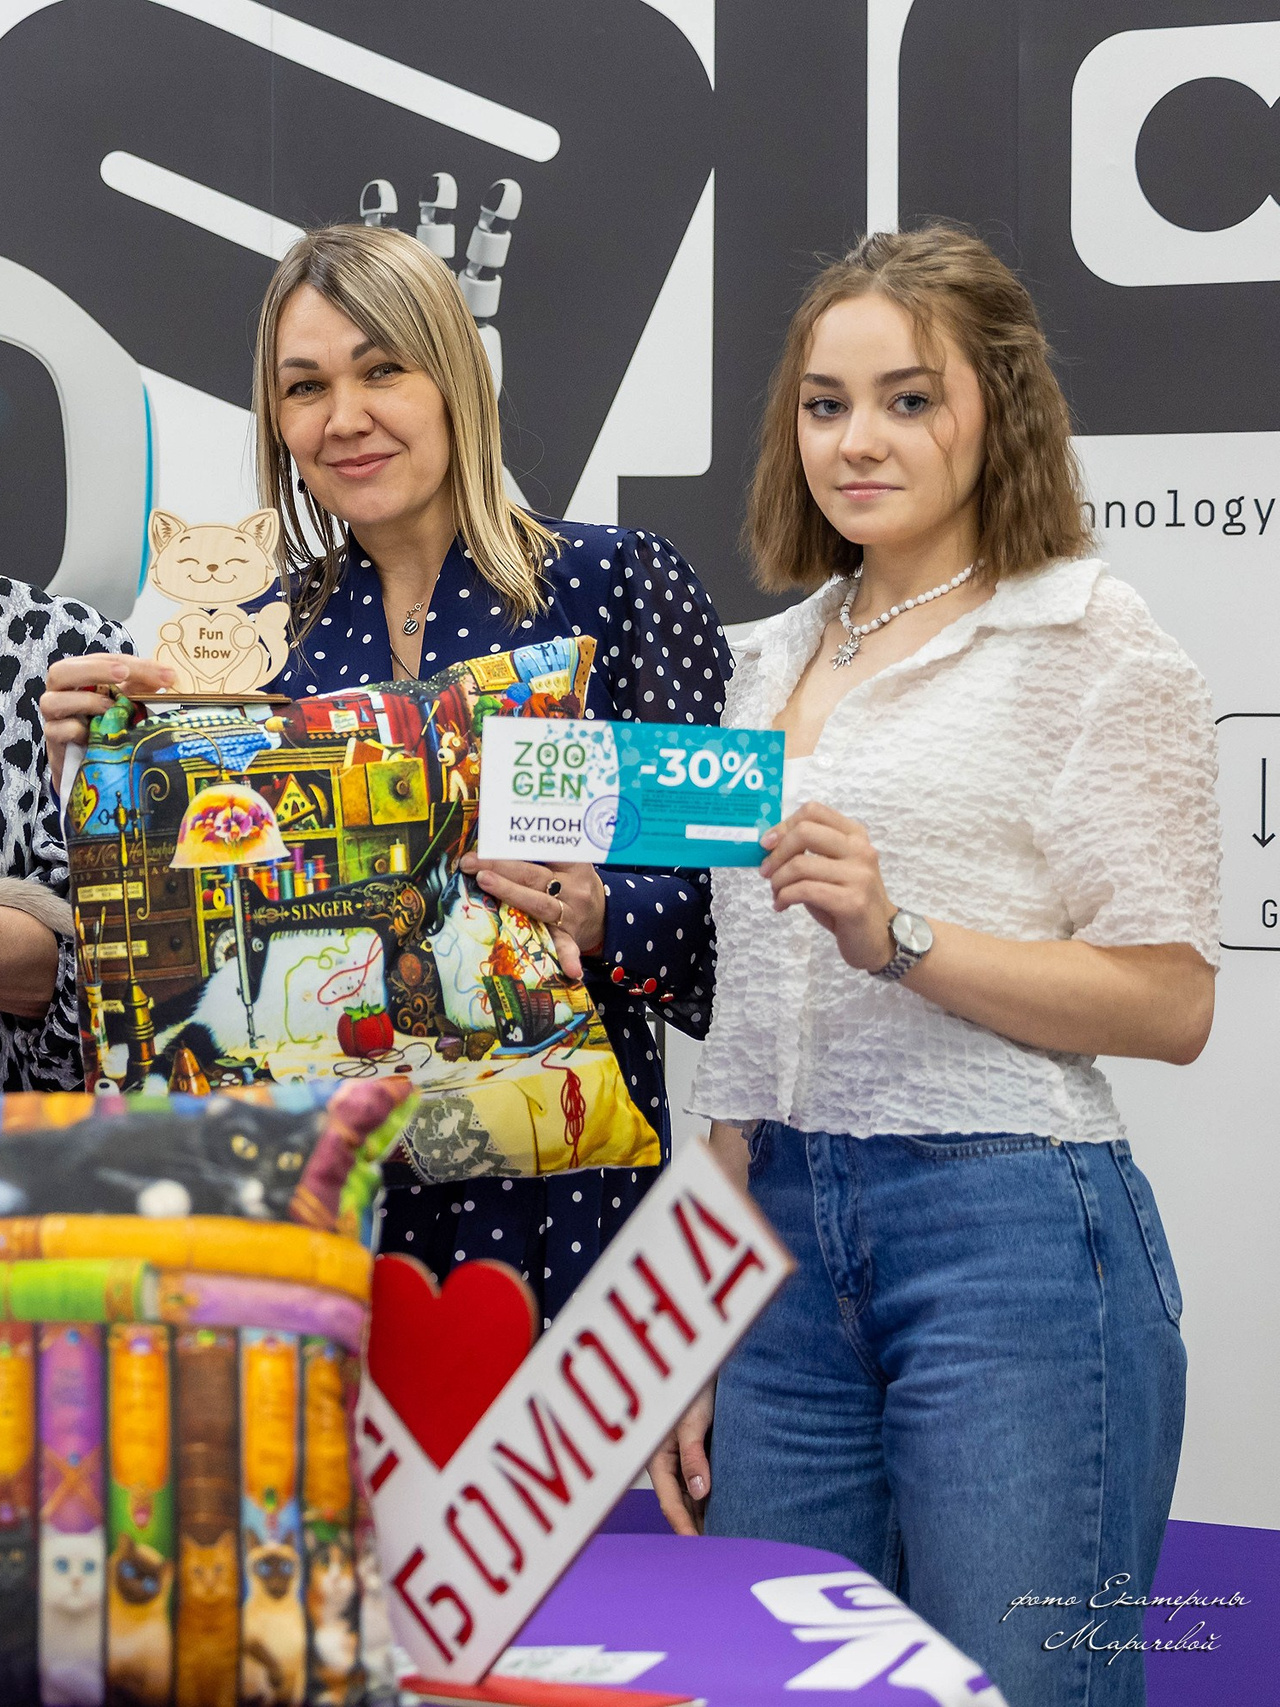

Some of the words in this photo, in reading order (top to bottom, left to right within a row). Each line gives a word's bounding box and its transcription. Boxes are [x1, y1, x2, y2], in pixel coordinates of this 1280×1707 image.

[198, 627, 224, 640] Fun
[193, 646, 232, 659] Show
[513, 740, 586, 769] ZOO
[640, 746, 765, 791] -30%
[511, 770, 583, 799] GEN
[510, 816, 582, 832] КУПОН
[509, 834, 526, 843] на
[529, 834, 582, 848] скидку
[291, 900, 354, 921] SINGER
[392, 1189, 767, 1666] БОМОНД
